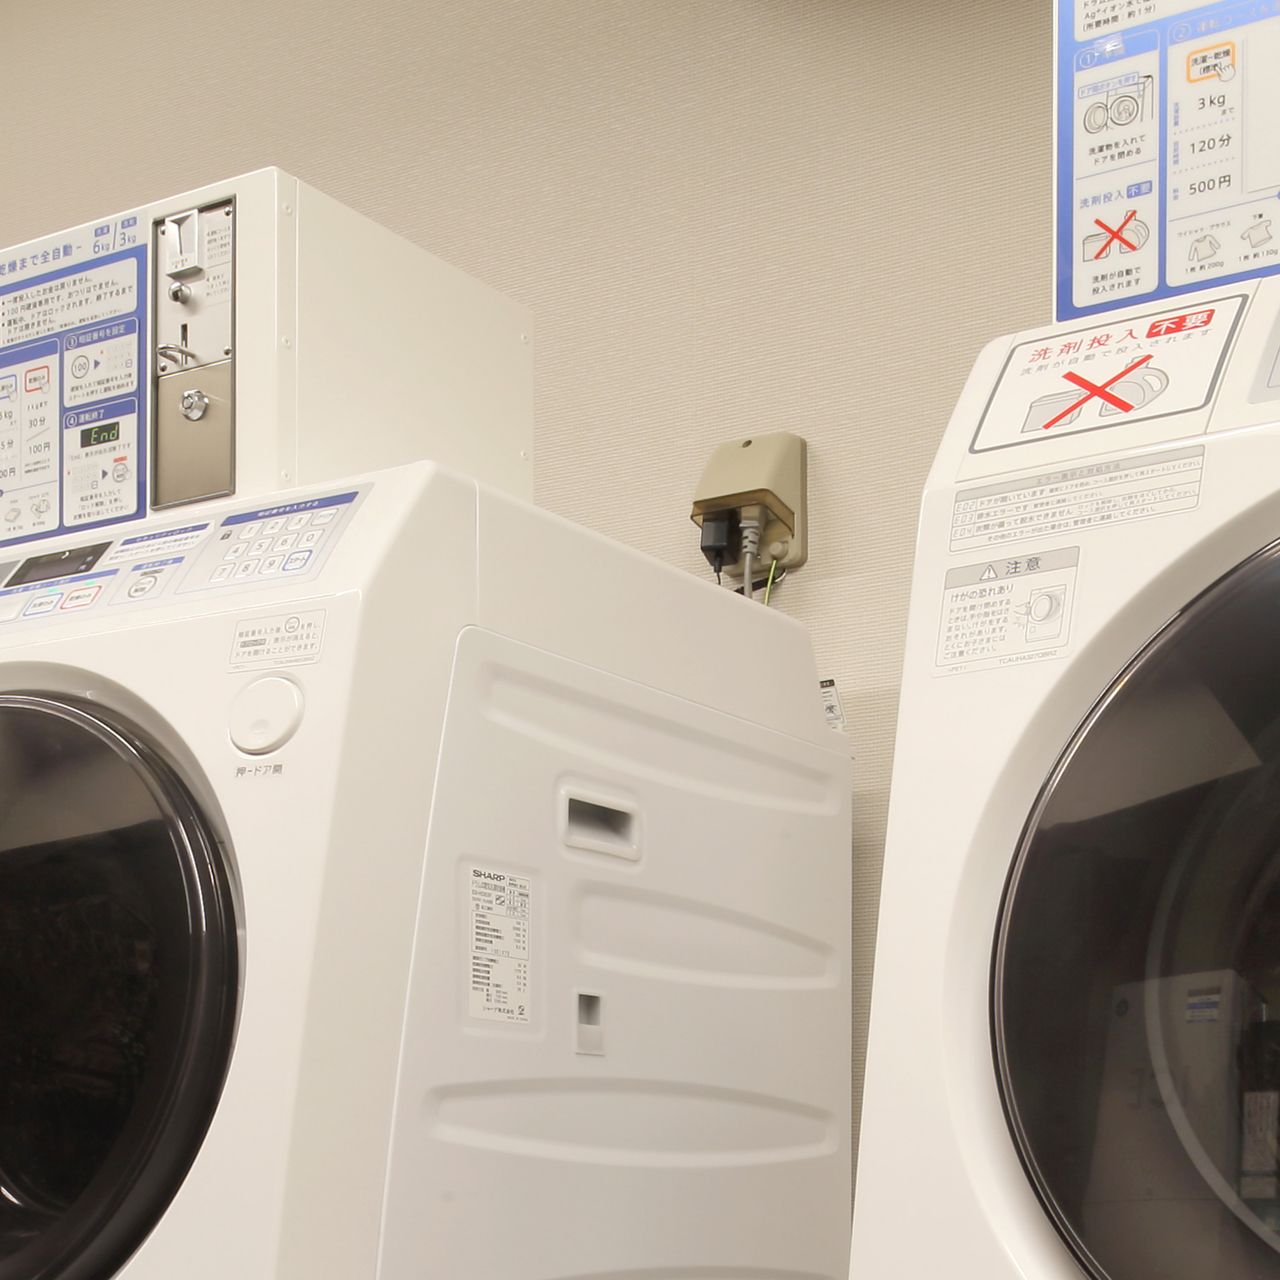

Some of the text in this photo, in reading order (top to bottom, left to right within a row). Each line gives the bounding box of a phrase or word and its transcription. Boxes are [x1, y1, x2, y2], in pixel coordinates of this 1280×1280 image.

[1221, 106, 1235, 116] まで
[1089, 135, 1146, 156] 洗濯物を入れて
[1189, 134, 1232, 155] 120分
[1093, 146, 1142, 166] ドアを閉める
[1080, 181, 1152, 209] 洗剤投入 不要
[1189, 175, 1231, 196] 500円
[1092, 266, 1141, 284] 洗剤が自動で
[1092, 278, 1141, 295] 投入されます
[1027, 310, 1209, 363] 洗剤投入 不要
[1020, 328, 1212, 375] 洗剤が自動で投入されます
[91, 425, 118, 445] End
[28, 442, 50, 454] 100円
[1005, 557, 1042, 575] 注意
[950, 584, 1014, 602] けがの恐れあり
[472, 869, 505, 882] SHARP
